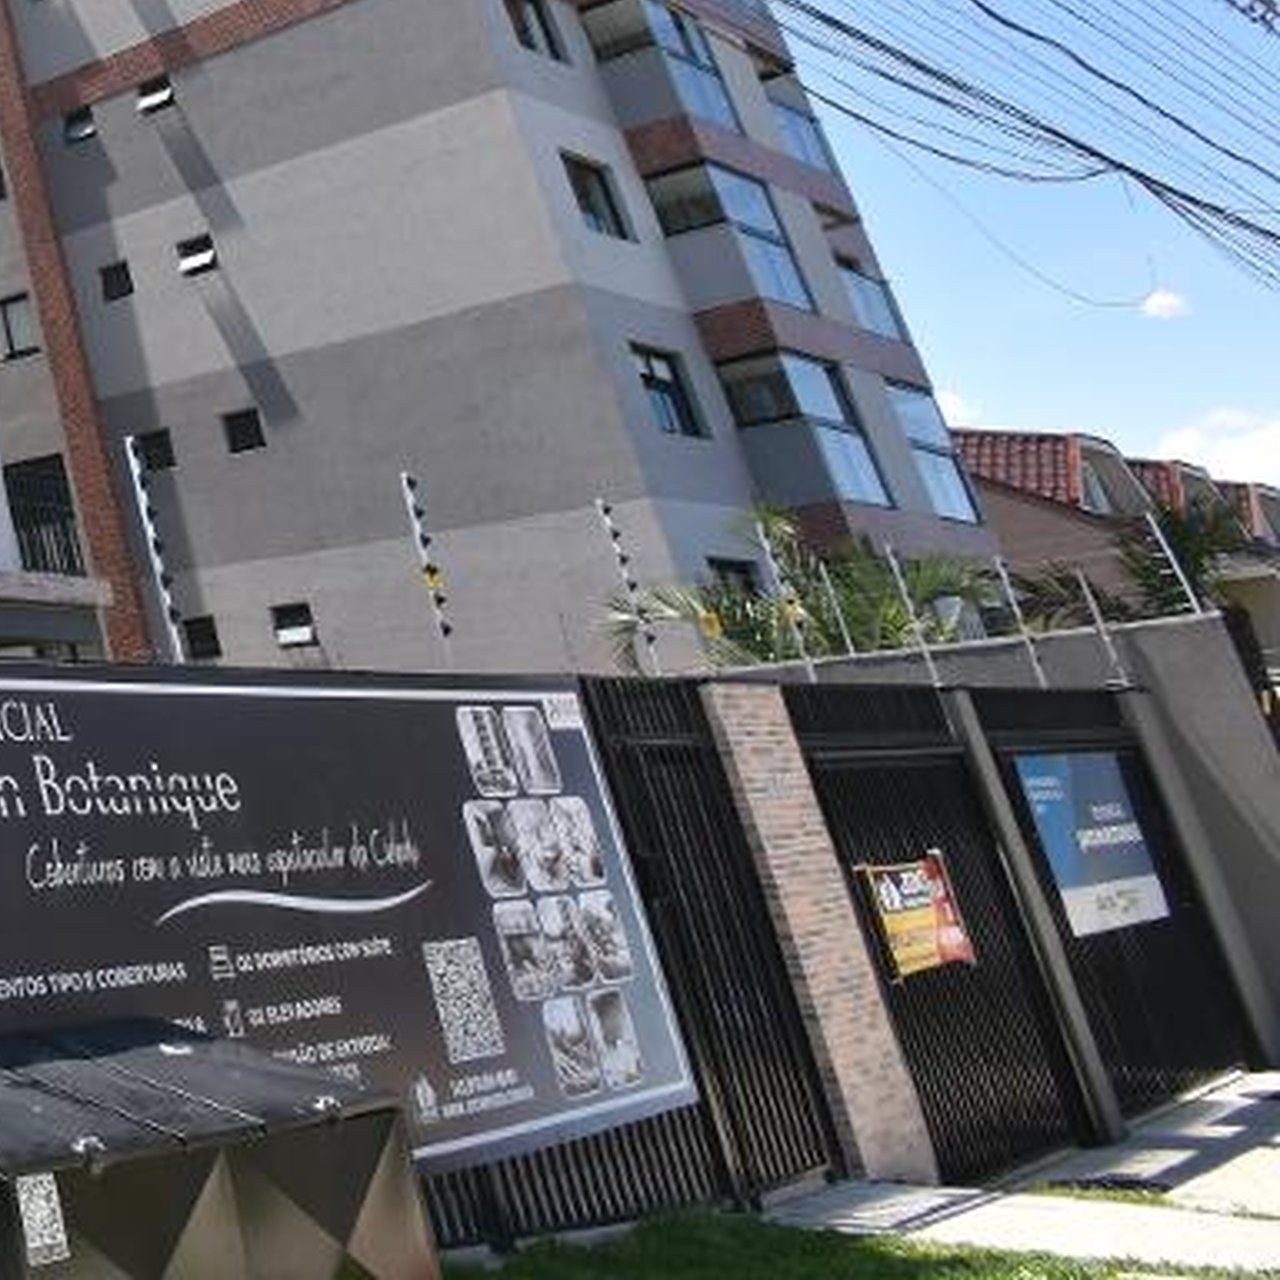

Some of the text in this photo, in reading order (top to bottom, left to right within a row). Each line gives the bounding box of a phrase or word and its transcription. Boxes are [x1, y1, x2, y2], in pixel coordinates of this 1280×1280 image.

[32, 754, 241, 830] Botanique
[48, 972, 83, 993] TIPO
[96, 962, 188, 990] COBERTURAS
